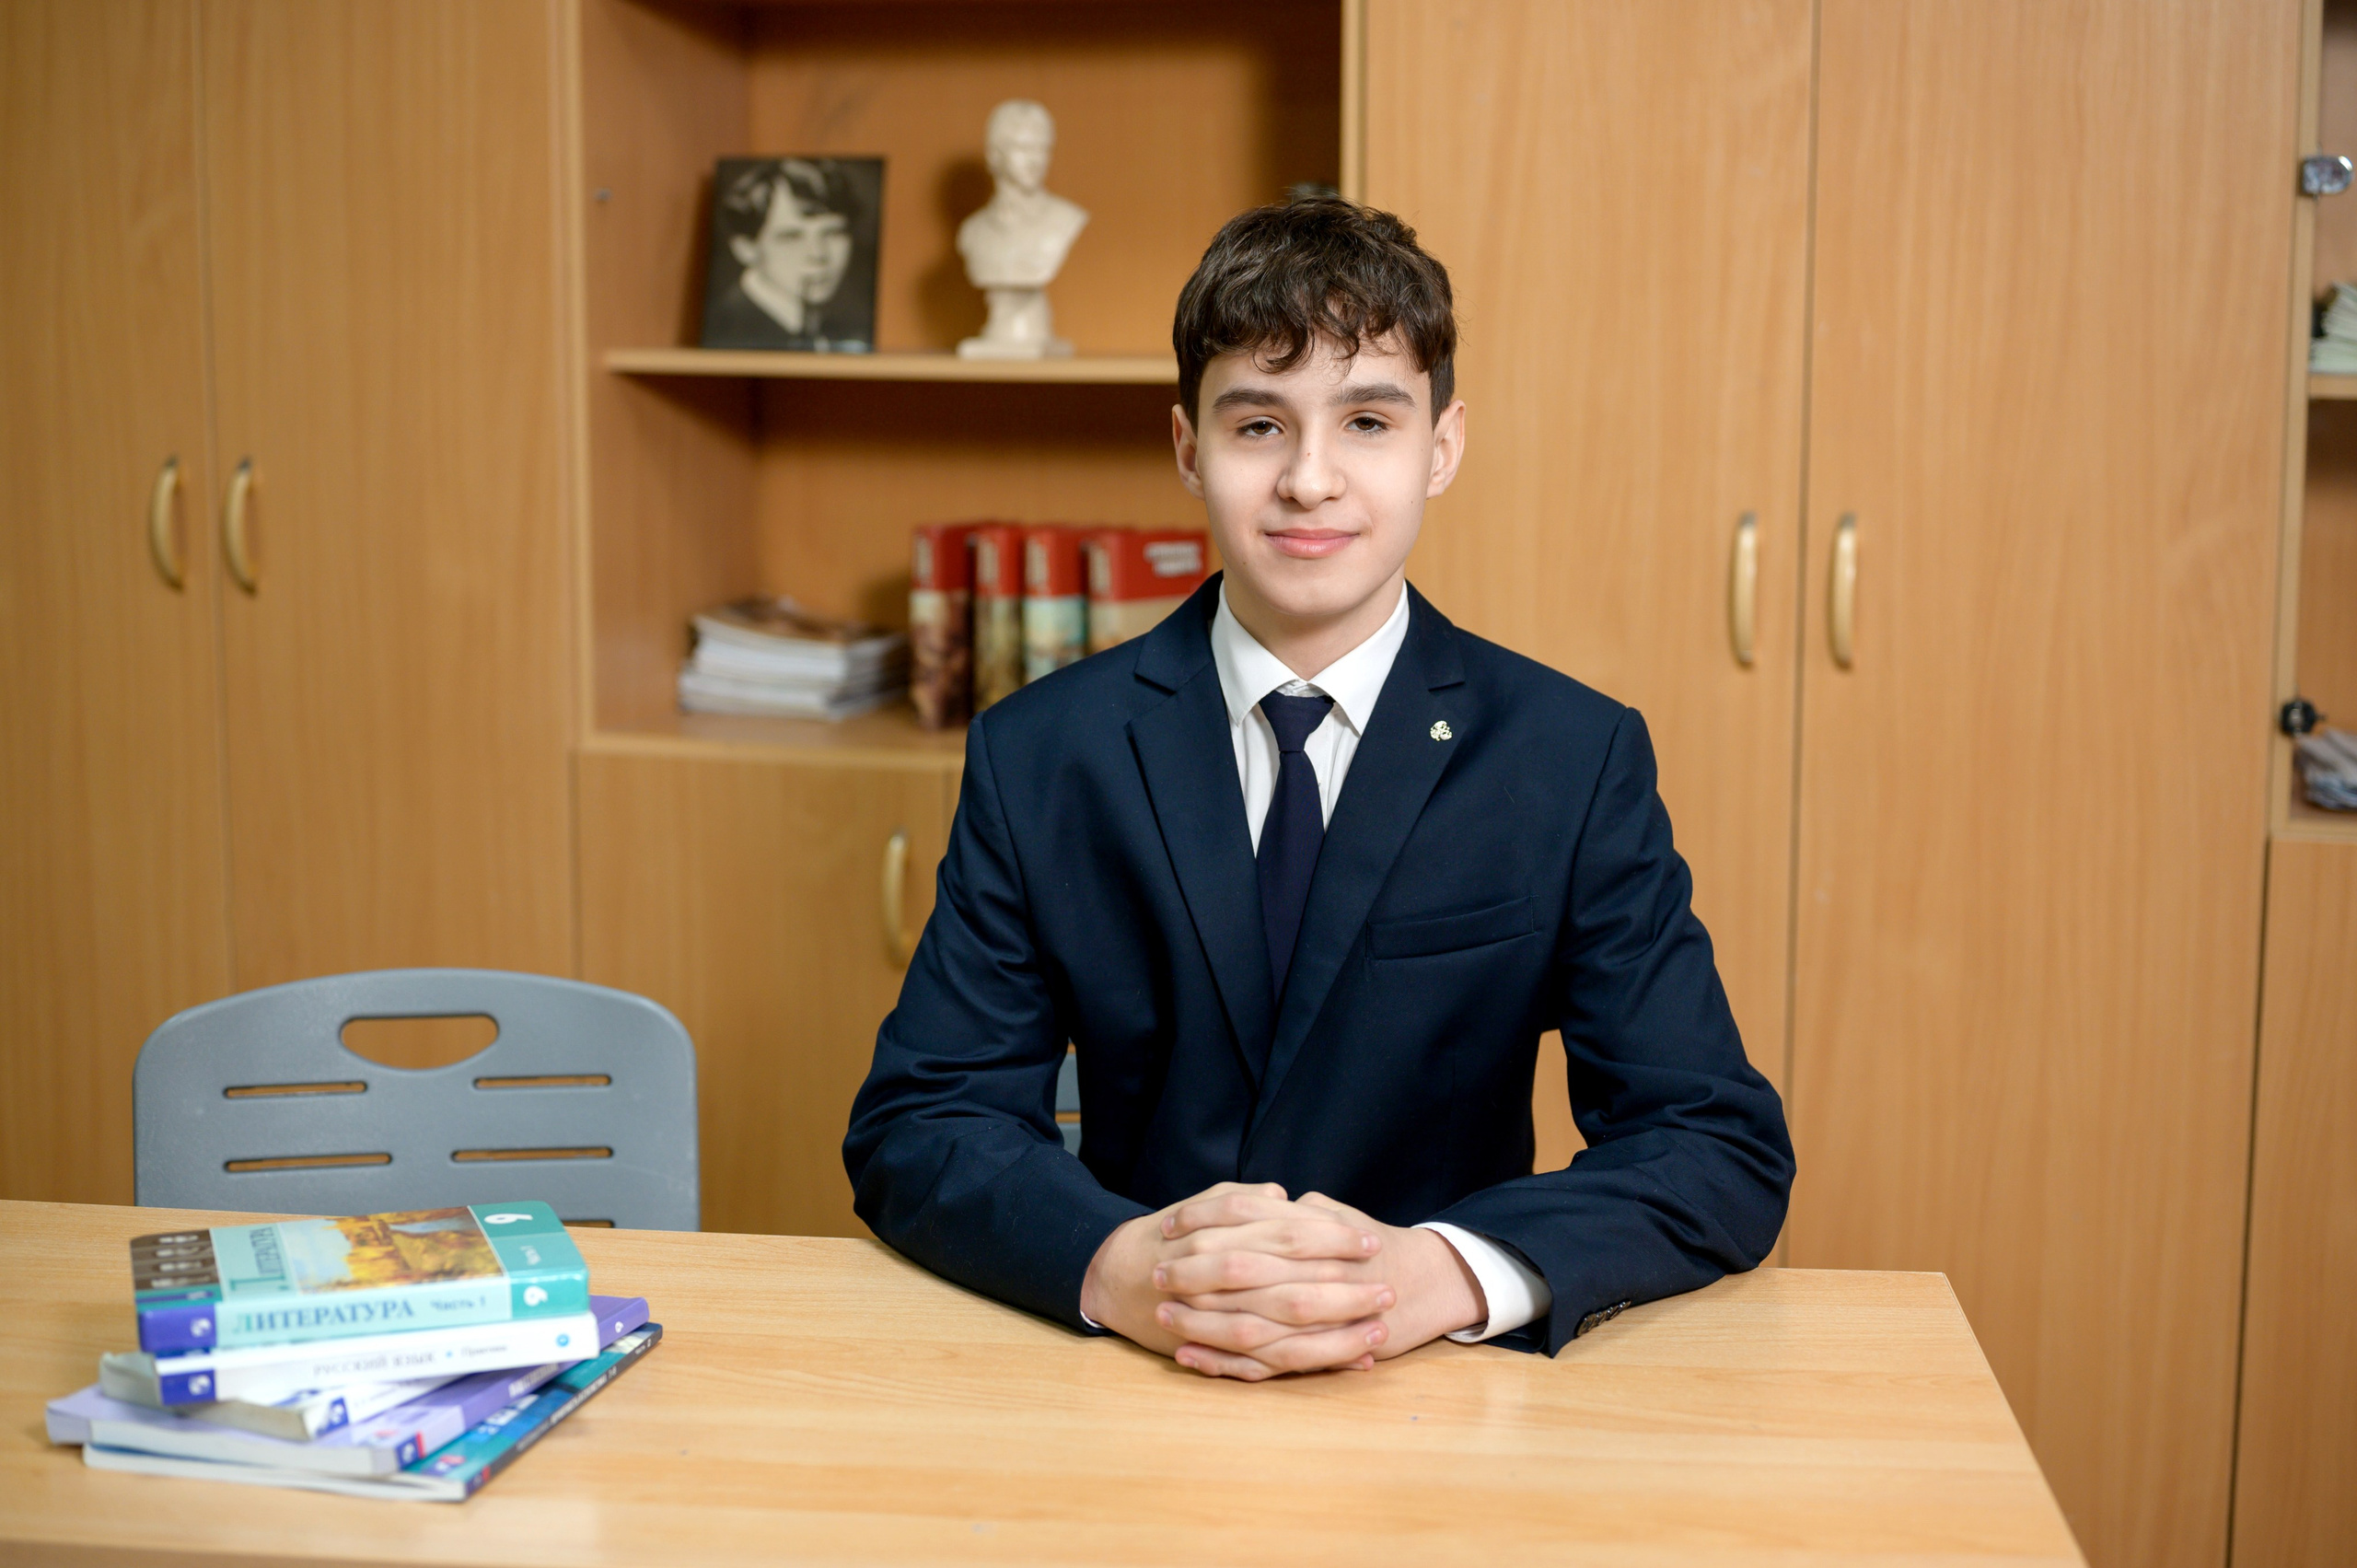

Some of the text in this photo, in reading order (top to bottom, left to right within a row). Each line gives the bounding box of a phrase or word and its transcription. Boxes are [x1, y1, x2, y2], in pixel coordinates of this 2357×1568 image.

[233, 1297, 414, 1332] ЛИТЕРАТУРА
[312, 1352, 389, 1376] РУССКИЙ
[393, 1349, 437, 1368] ЯЗЫК
